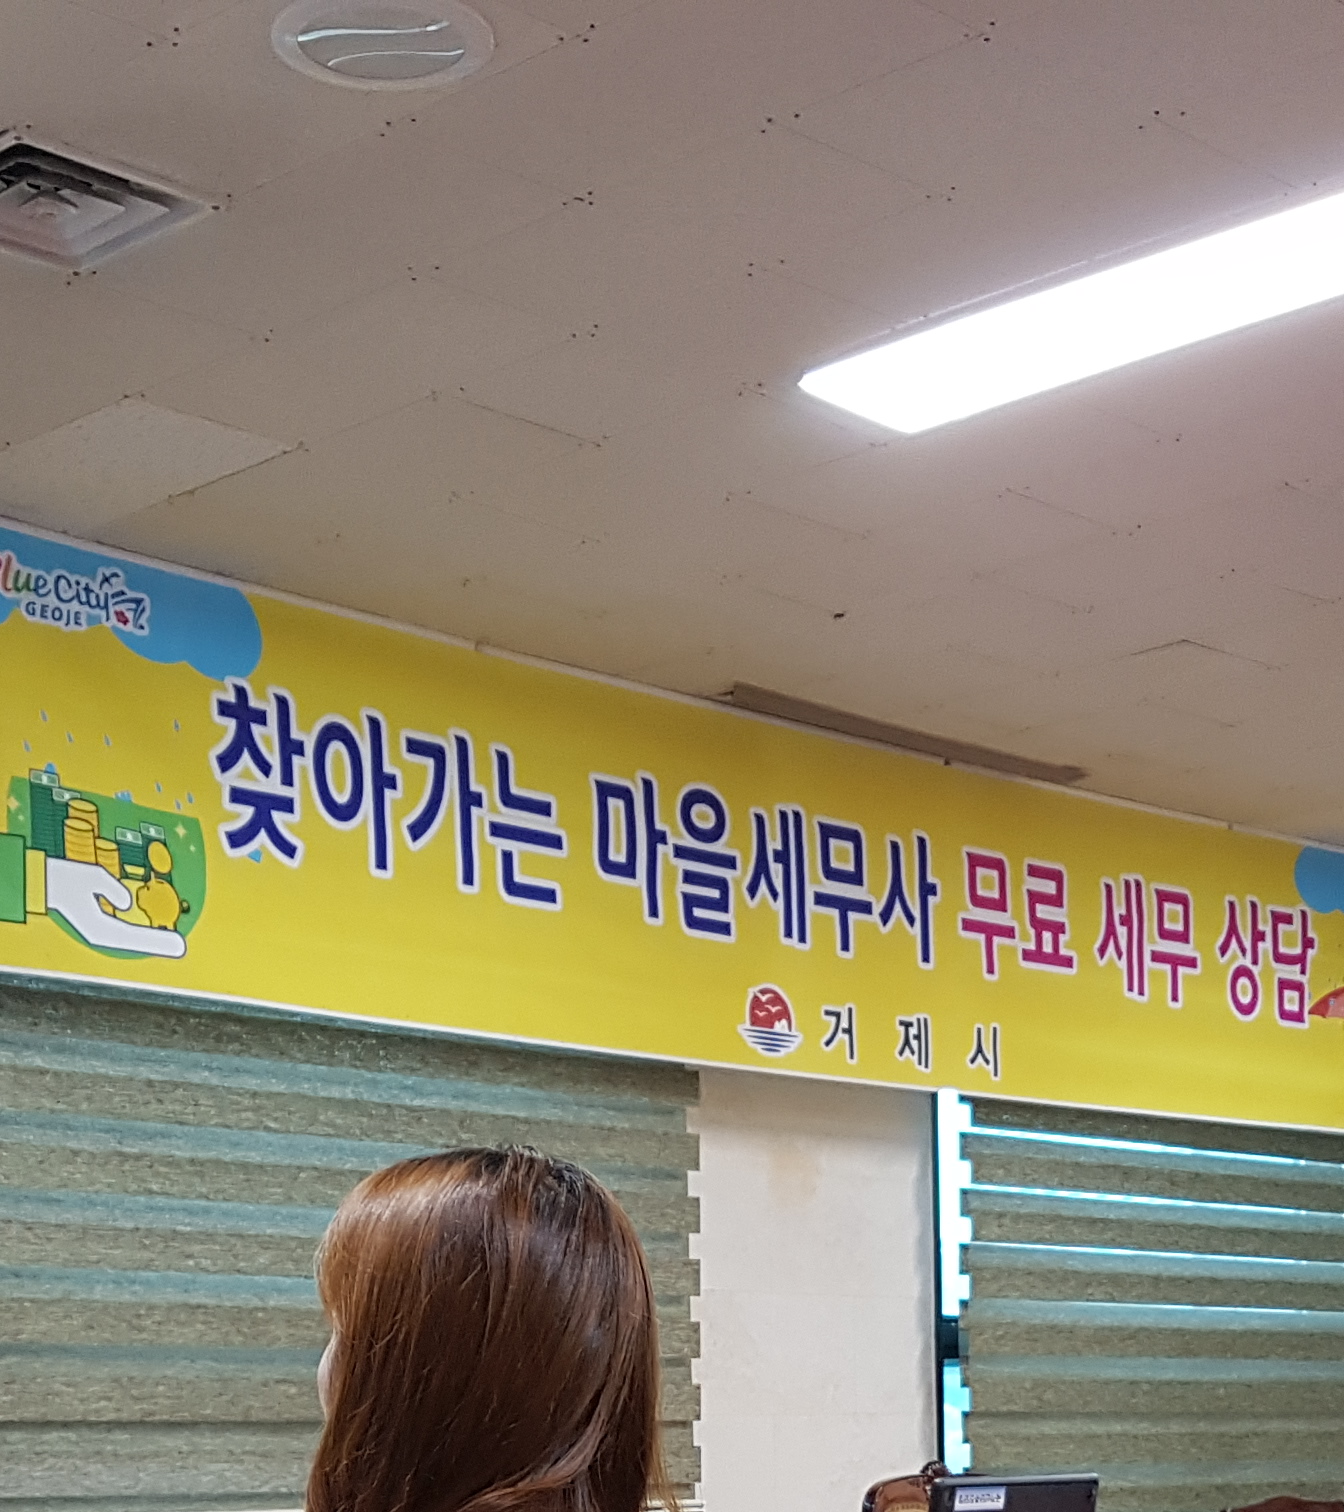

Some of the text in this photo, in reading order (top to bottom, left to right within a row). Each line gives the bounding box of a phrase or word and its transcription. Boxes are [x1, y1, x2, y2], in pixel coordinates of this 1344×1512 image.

[25, 601, 83, 626] GEOJE
[55, 572, 110, 623] City
[216, 682, 1316, 1025] 찾아가는 마을세무사 무료 세무 상담
